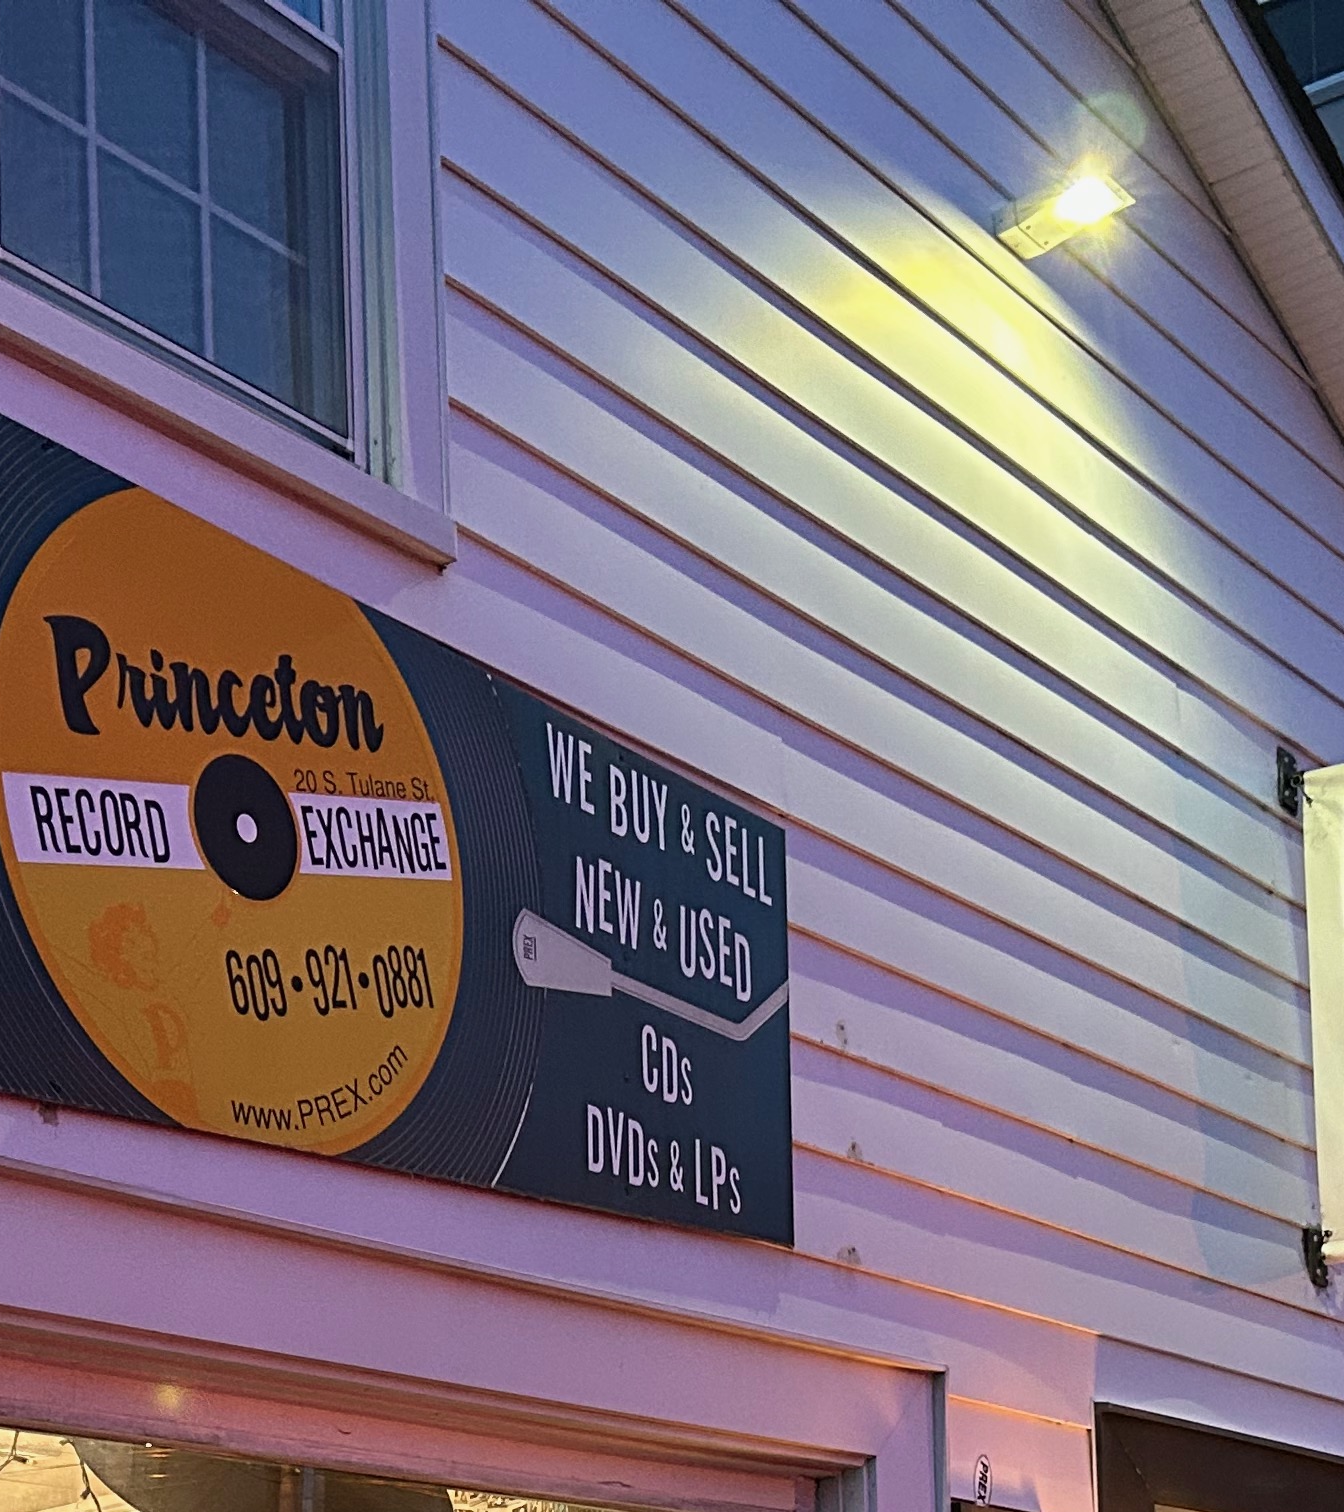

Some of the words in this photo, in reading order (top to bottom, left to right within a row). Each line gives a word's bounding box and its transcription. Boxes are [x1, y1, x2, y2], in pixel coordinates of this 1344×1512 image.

[44, 616, 384, 754] Princeton
[30, 784, 170, 863] RECORD
[305, 805, 447, 872] EXCHANGE
[294, 769, 317, 793] 20
[323, 770, 343, 794] S.
[346, 772, 406, 799] Tulane
[410, 777, 435, 801] St.
[546, 722, 595, 815] WE
[609, 763, 669, 851] BUY
[680, 805, 696, 853] &
[706, 811, 773, 907] SELL
[523, 934, 535, 961] PREX
[574, 855, 640, 950] NEW
[653, 899, 668, 951] &
[679, 904, 752, 1004] USED
[231, 1045, 408, 1132] www.PREX.com
[641, 1023, 692, 1107] CDs
[586, 1104, 659, 1189] DVDs
[669, 1143, 684, 1193] &
[694, 1137, 740, 1216] LPs
[977, 1461, 990, 1504] PREX
